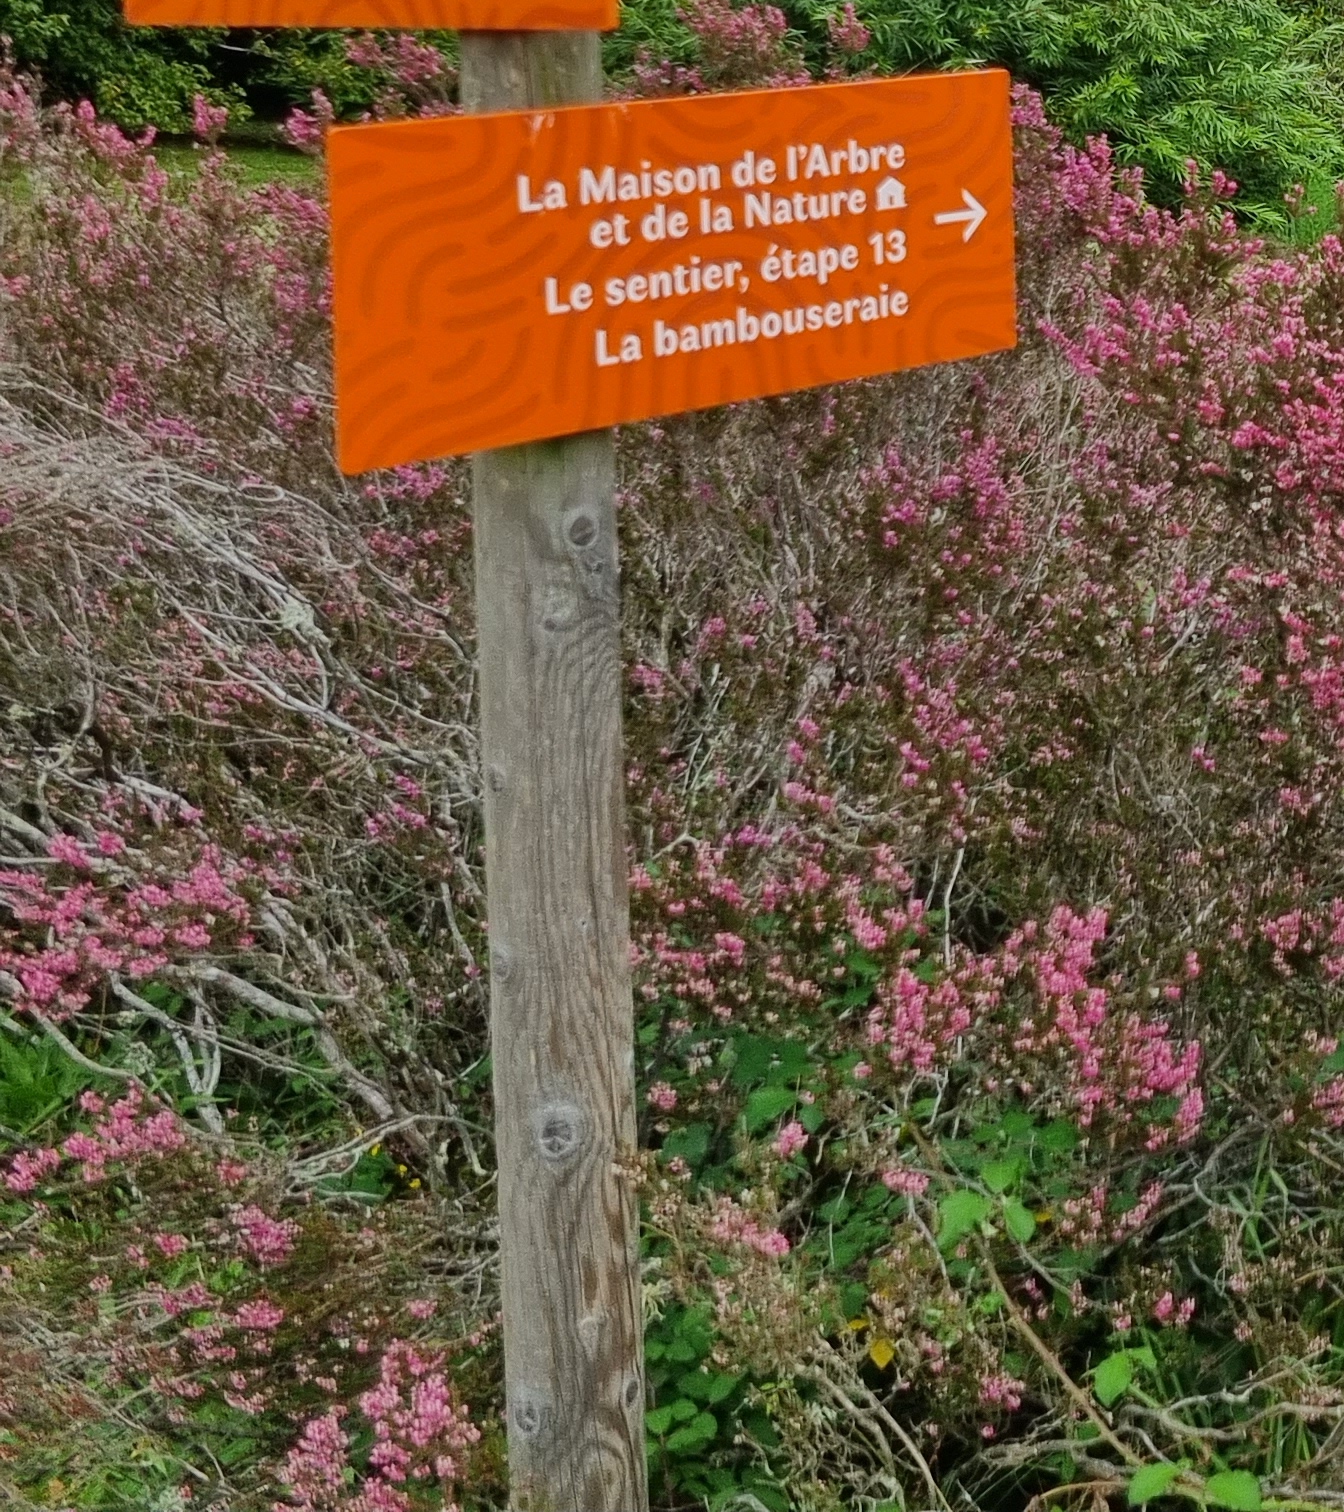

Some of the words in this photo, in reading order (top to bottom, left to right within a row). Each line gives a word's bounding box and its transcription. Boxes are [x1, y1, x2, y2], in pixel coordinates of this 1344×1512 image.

[516, 173, 568, 214] La
[579, 159, 721, 207] Maison
[731, 149, 777, 189] de
[588, 212, 631, 249] et
[640, 202, 689, 243] de
[699, 197, 735, 235] la
[743, 186, 868, 229] Nature
[544, 276, 594, 316] Le
[604, 255, 751, 307] sentier,
[759, 242, 860, 286] étape
[868, 228, 908, 266] 13
[594, 328, 644, 368] La
[653, 282, 910, 358] bambouseraie
